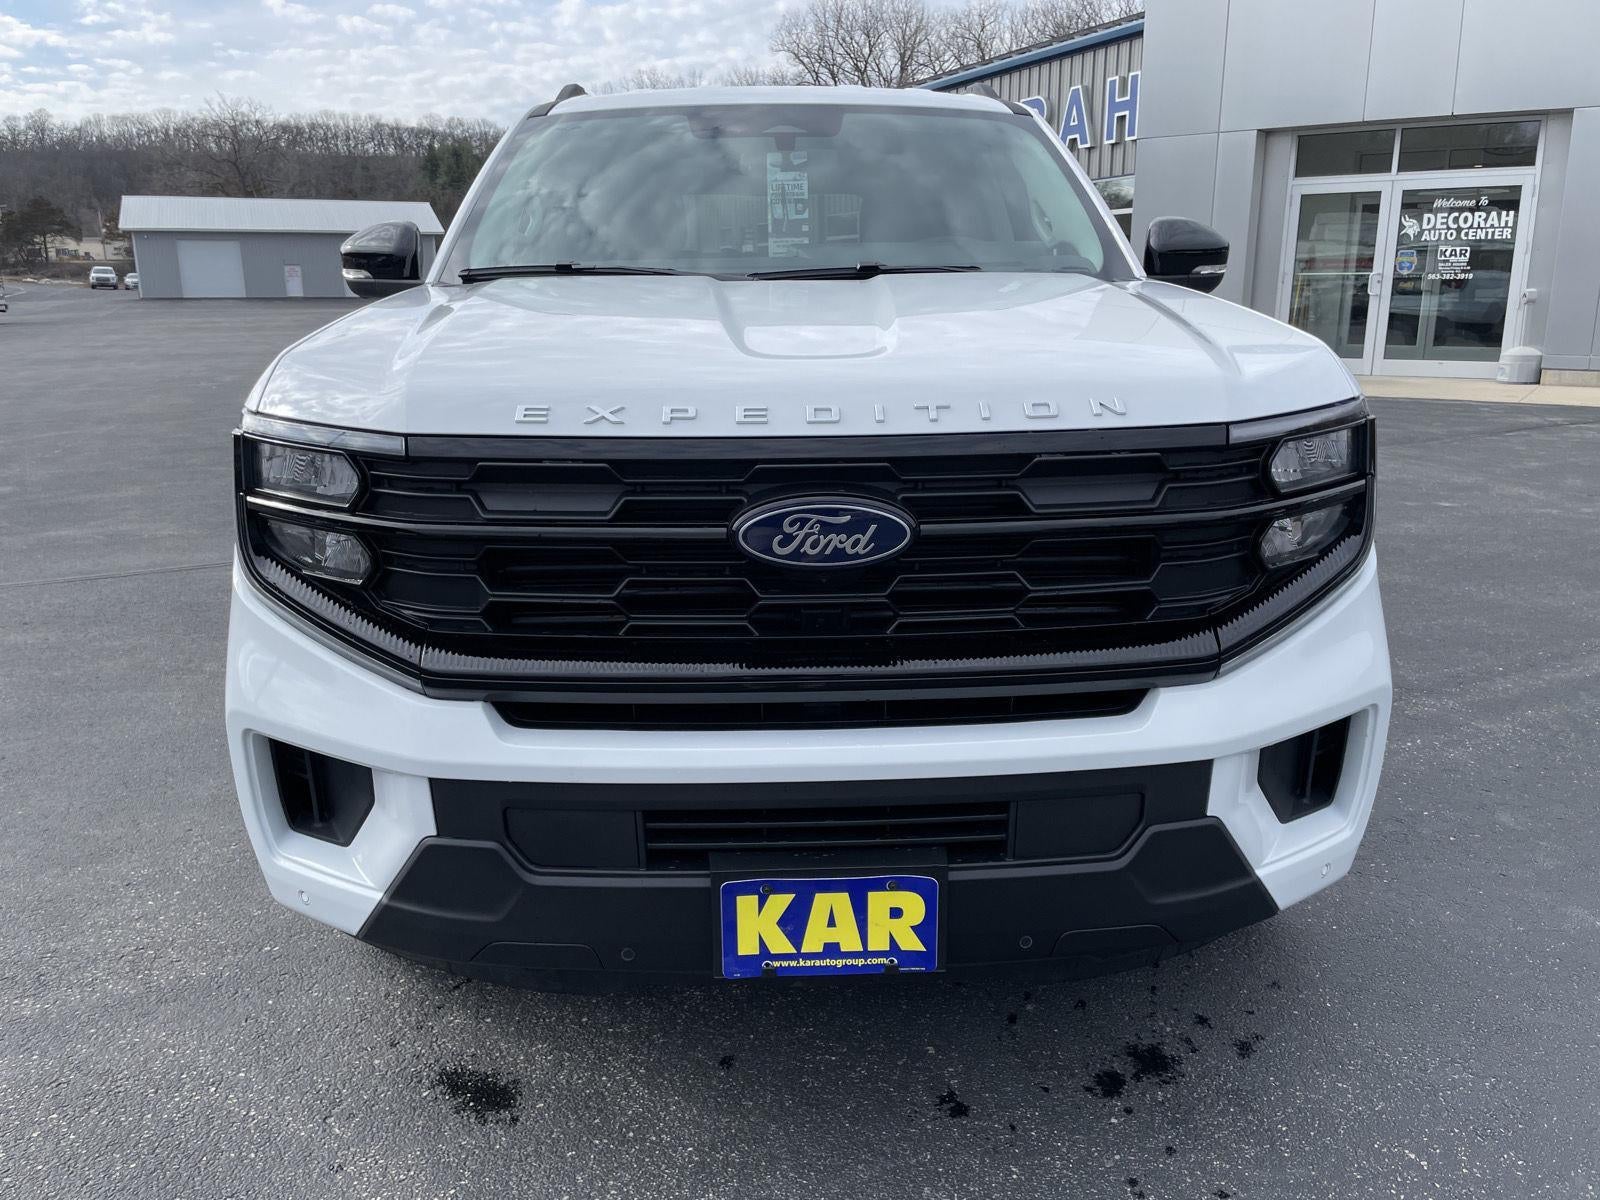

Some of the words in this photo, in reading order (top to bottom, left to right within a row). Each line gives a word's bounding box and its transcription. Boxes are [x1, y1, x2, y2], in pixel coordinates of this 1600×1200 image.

[1019, 71, 1141, 149] AH
[1433, 197, 1476, 209] Welcome
[1478, 196, 1489, 206] To
[1421, 210, 1515, 230] DECORAH
[1421, 229, 1457, 241] AUTO
[1460, 228, 1512, 240] CENTER
[1438, 247, 1469, 259] KAR
[514, 396, 1127, 425] EXPEDITION
[772, 513, 878, 556] Ford
[736, 891, 927, 956] KAR
[772, 957, 887, 968] www.karautogroup.com
